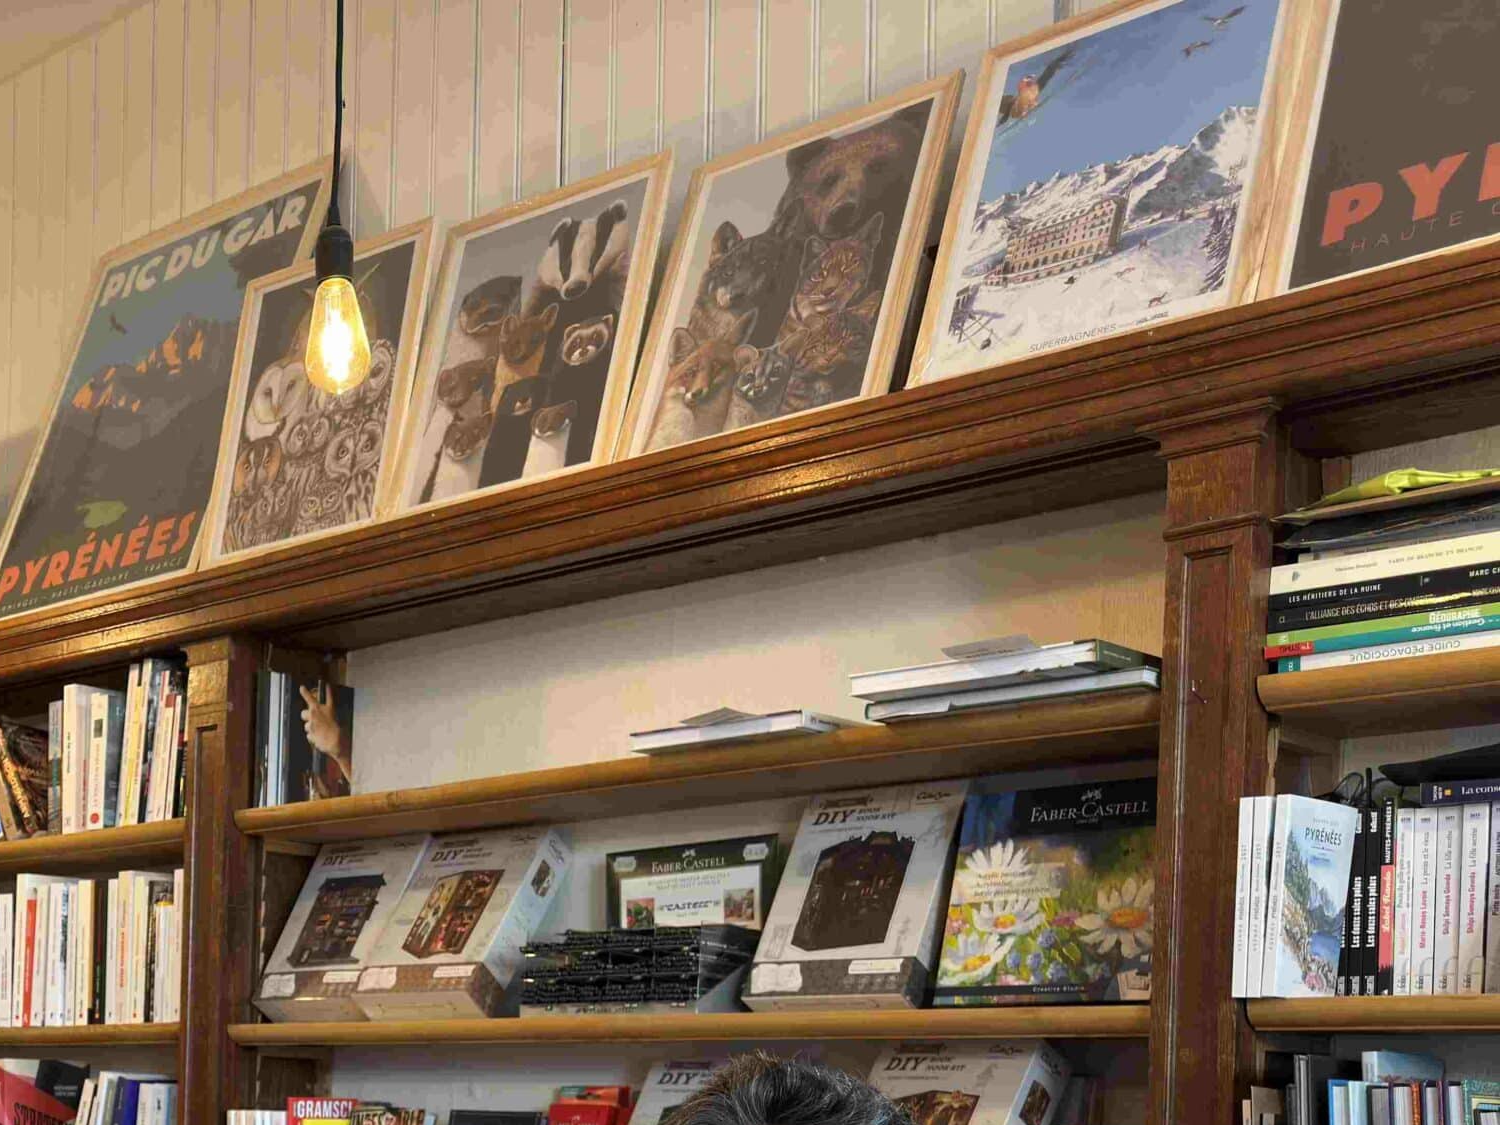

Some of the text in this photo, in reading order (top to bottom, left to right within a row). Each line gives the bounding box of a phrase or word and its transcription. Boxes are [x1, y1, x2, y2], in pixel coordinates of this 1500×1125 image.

[1350, 210, 1463, 254] HAUTE
[101, 196, 307, 307] PIC DU GAR
[1469, 568, 1490, 578] MARC
[1349, 639, 1460, 662] GUIDE PÉDAGOGIQUE
[1461, 785, 1473, 795] La
[812, 809, 854, 825] DIY
[1031, 799, 1149, 824] FABER-CASTELL
[1304, 825, 1343, 847] PYRÉNÉES
[884, 1056, 927, 1072] DIY
[658, 1071, 698, 1085] DIY
